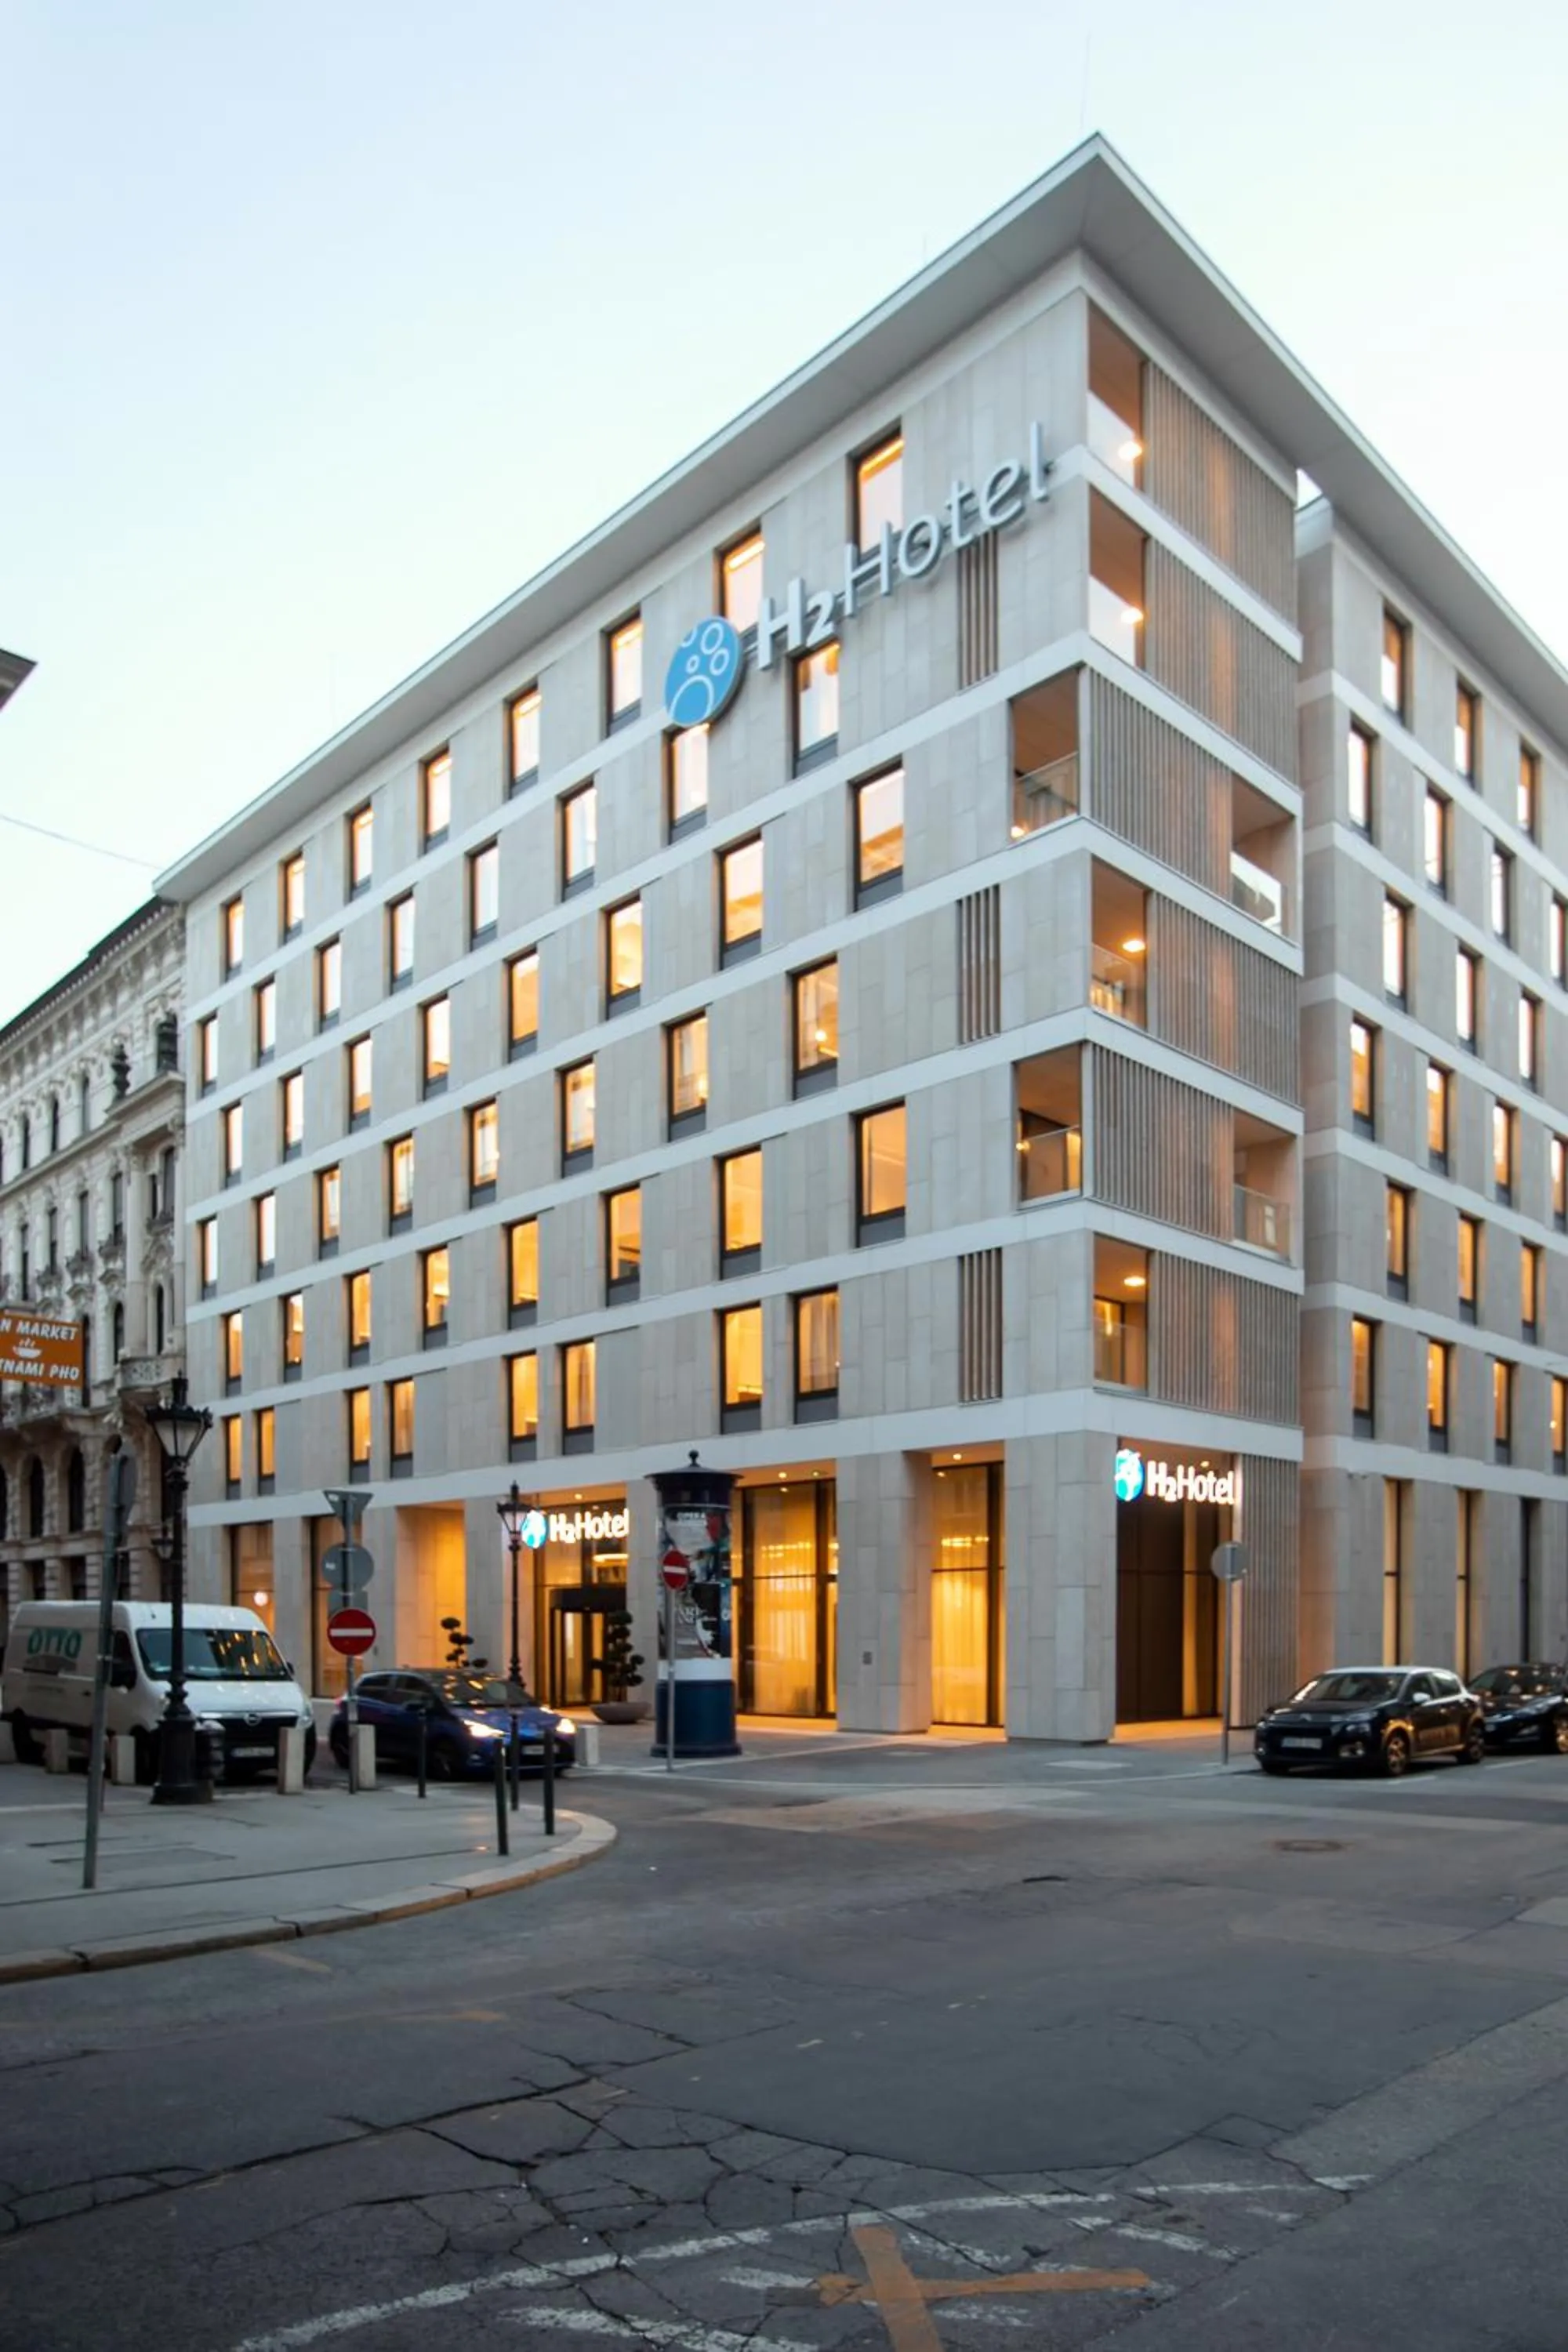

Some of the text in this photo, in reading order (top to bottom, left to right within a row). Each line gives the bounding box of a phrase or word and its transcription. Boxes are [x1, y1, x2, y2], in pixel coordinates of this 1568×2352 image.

[16, 1320, 77, 1341] MARKET
[49, 1365, 80, 1380] PHO
[27, 1627, 82, 1659] OTTO
